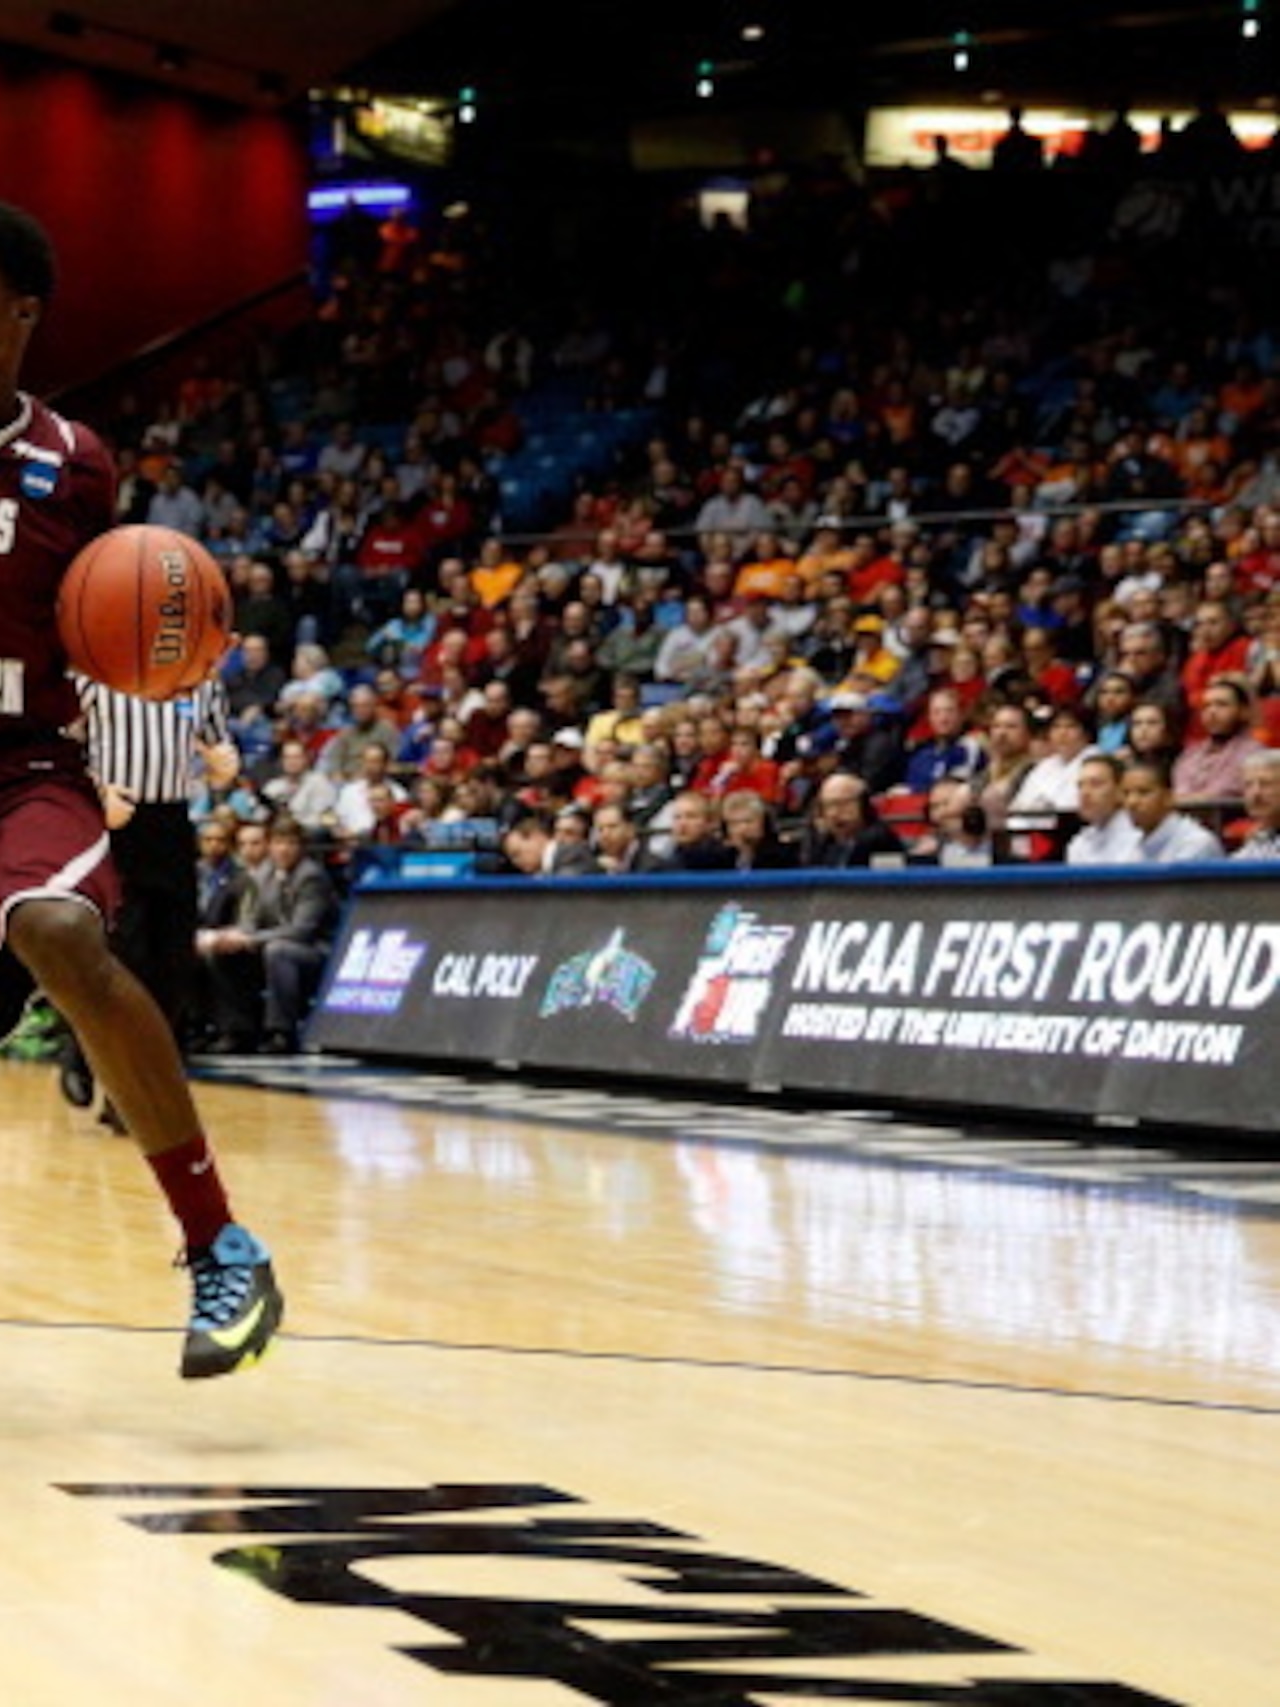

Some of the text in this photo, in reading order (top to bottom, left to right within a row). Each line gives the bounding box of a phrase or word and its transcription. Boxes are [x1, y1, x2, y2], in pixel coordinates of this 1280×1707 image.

[432, 951, 476, 997] CAL
[472, 953, 540, 999] POLY
[791, 919, 1280, 1011] NCAA FIRST ROUND
[781, 1002, 1247, 1066] HOSTED BY THE UNIVERSITY OF DAYTON
